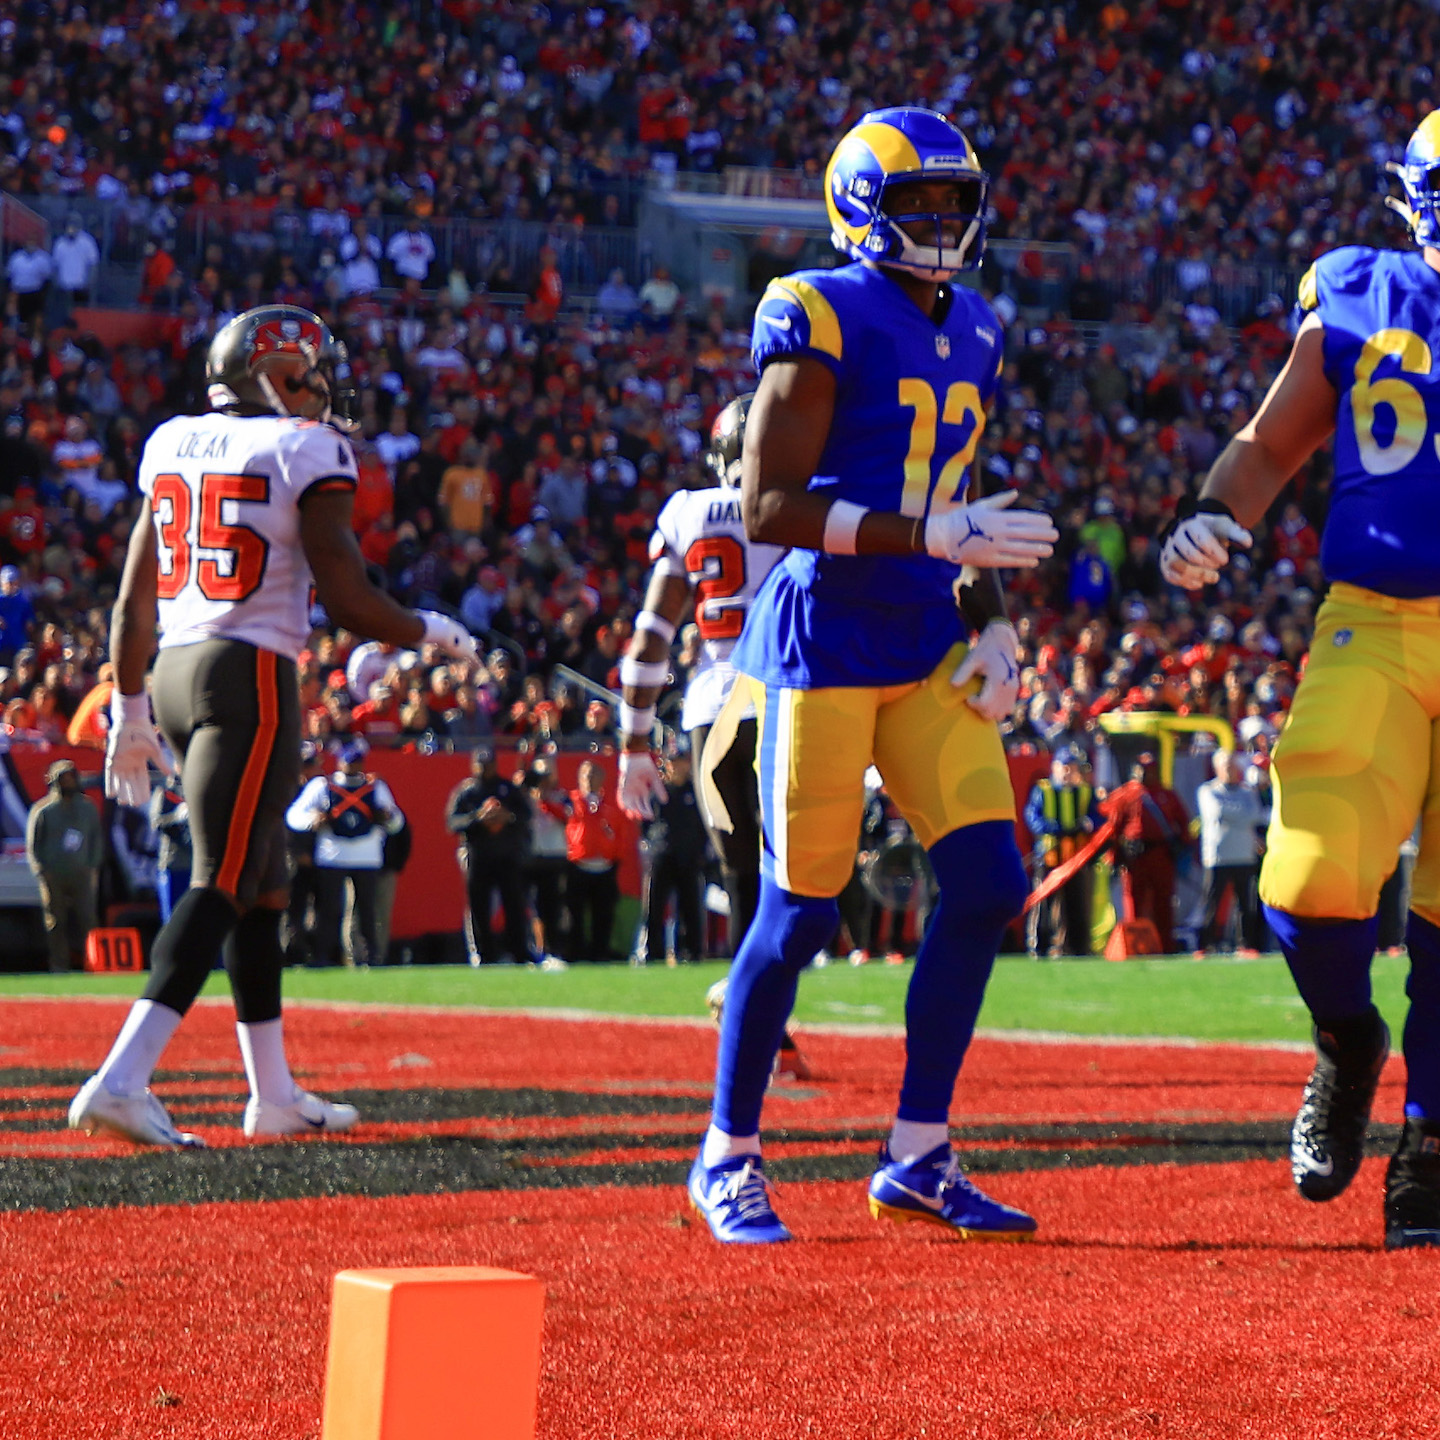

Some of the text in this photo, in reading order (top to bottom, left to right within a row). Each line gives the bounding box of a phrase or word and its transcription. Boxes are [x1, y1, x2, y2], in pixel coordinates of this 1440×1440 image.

[176, 431, 232, 459] DEAN
[898, 377, 987, 519] 12
[152, 472, 270, 602] 35
[101, 937, 133, 969] 10
